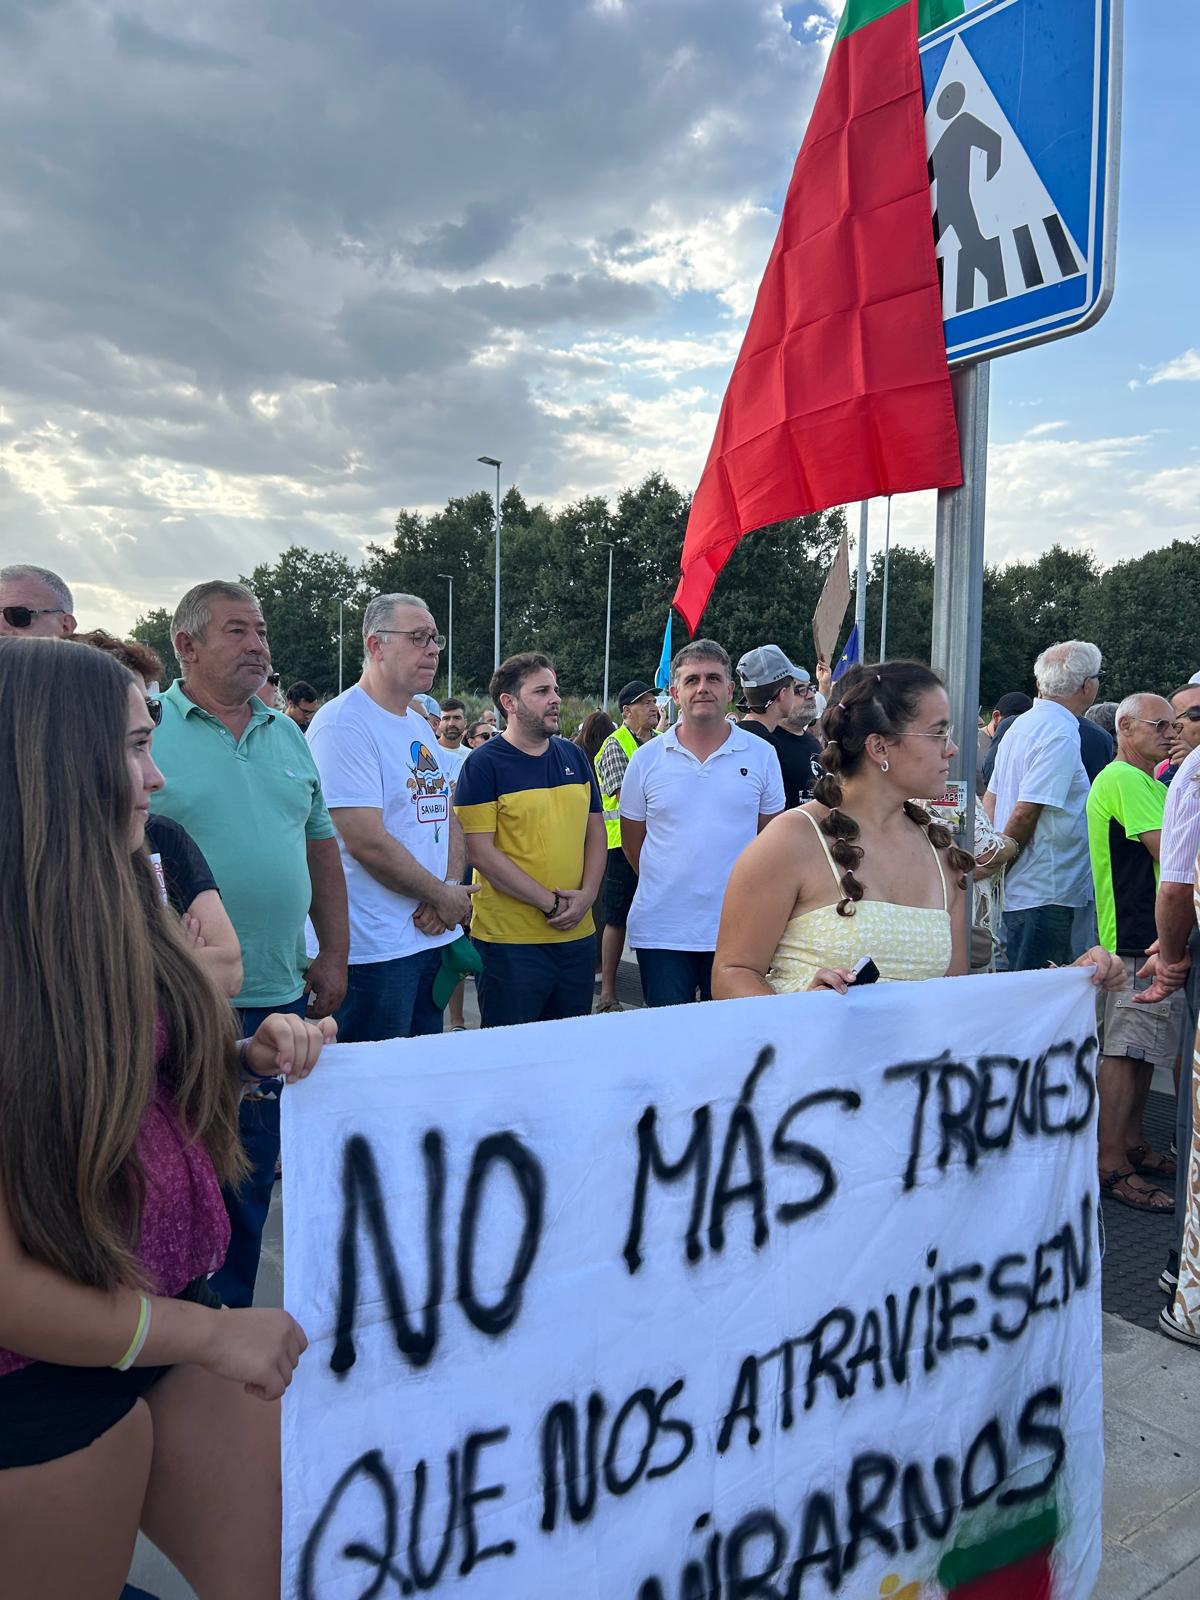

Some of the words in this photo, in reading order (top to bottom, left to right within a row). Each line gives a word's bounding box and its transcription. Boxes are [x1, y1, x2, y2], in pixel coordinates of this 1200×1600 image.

[300, 1425, 517, 1600] QUE
[540, 1378, 694, 1532] NOS
[716, 1192, 1092, 1454] ATRAVIESEN
[330, 1127, 546, 1381] NO
[623, 1044, 861, 1274] MÁS
[884, 1036, 1098, 1192] TRENES
